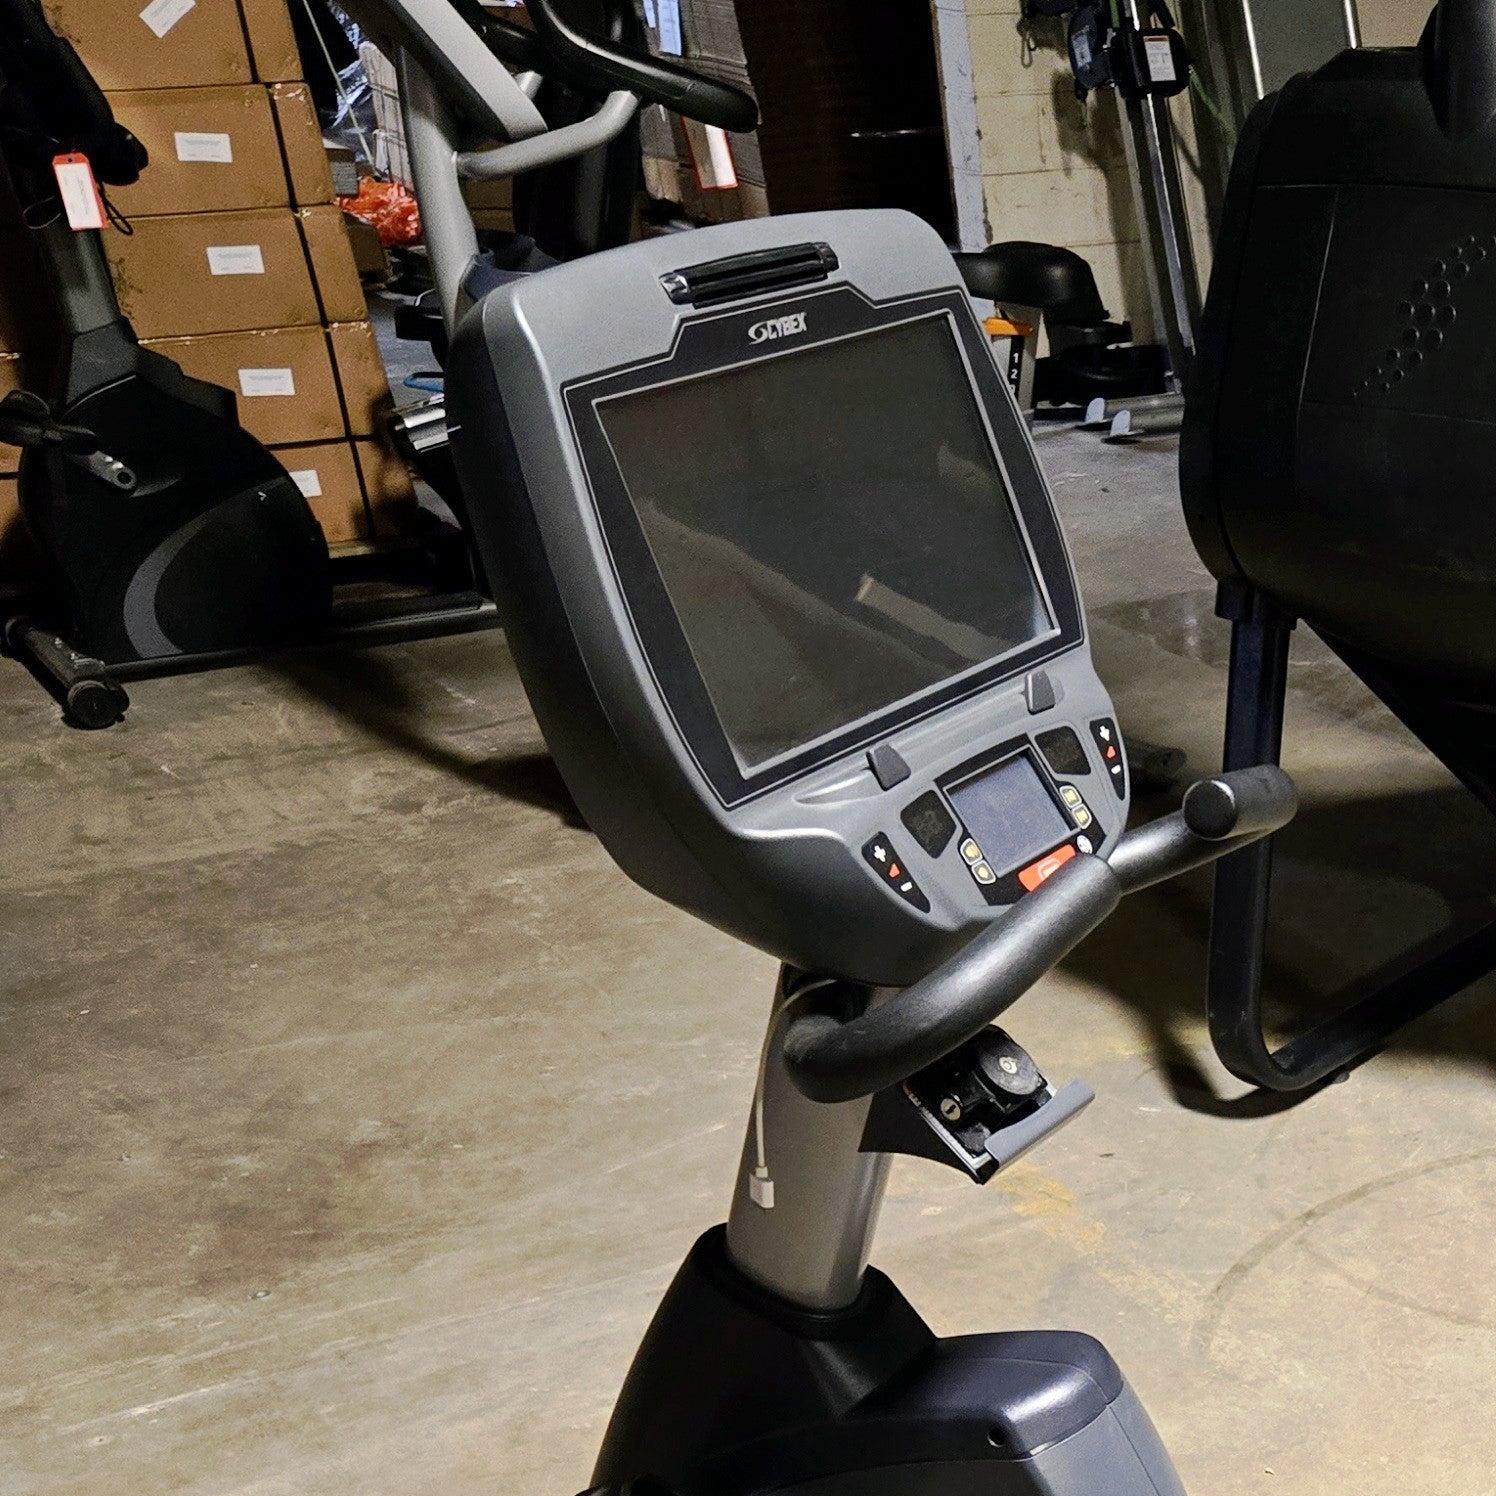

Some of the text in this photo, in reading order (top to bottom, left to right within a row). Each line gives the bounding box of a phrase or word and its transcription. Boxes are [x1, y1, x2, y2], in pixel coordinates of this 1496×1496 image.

[766, 311, 807, 340] CYBEX
[1013, 352, 1019, 363] 1
[1010, 368, 1018, 379] 2
